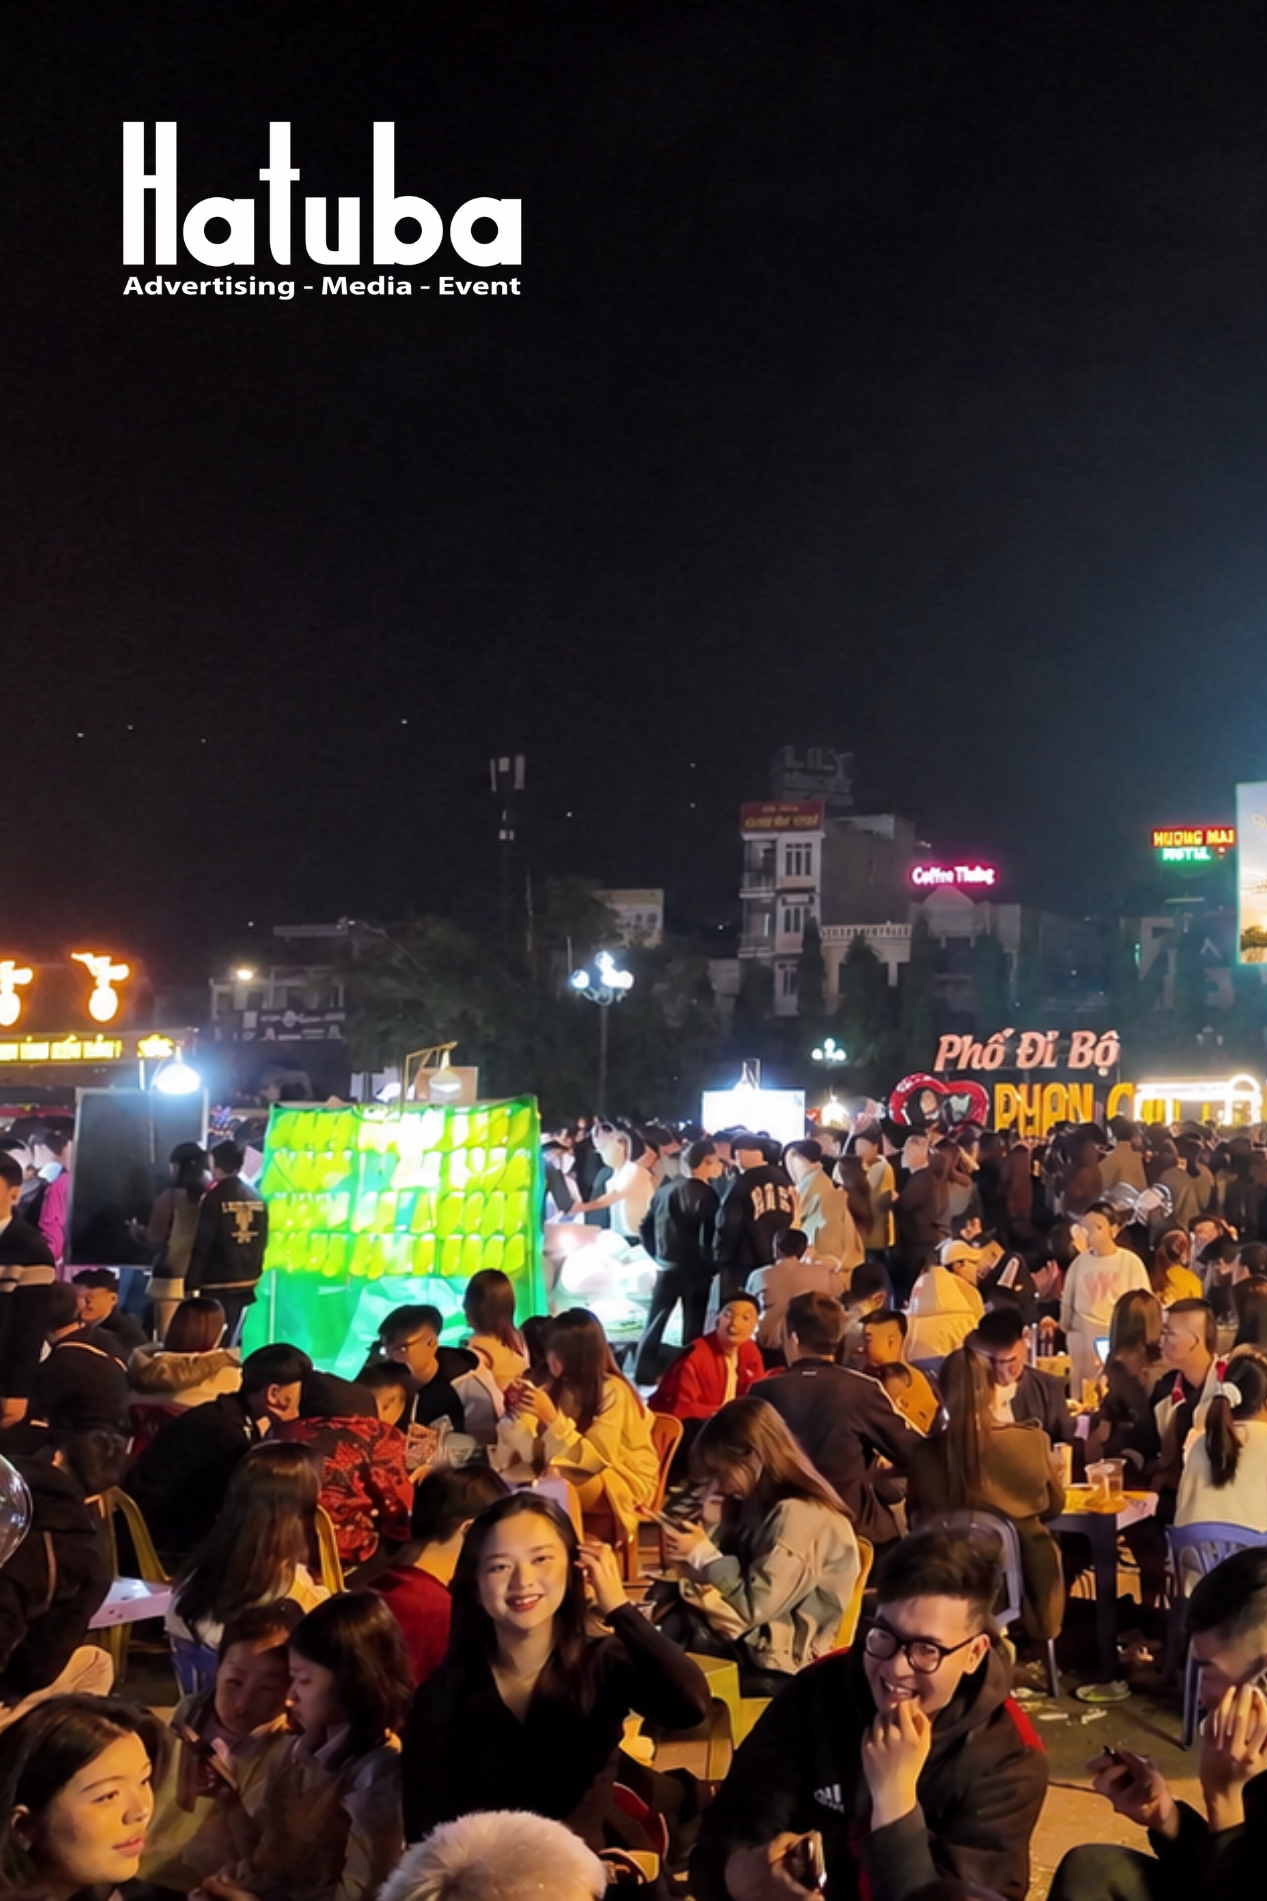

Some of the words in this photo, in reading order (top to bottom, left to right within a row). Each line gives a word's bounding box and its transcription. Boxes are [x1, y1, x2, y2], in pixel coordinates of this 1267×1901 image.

[933, 1027, 1016, 1072] Phố
[1015, 1029, 1060, 1070] Đi
[1066, 1029, 1121, 1078] Bộ
